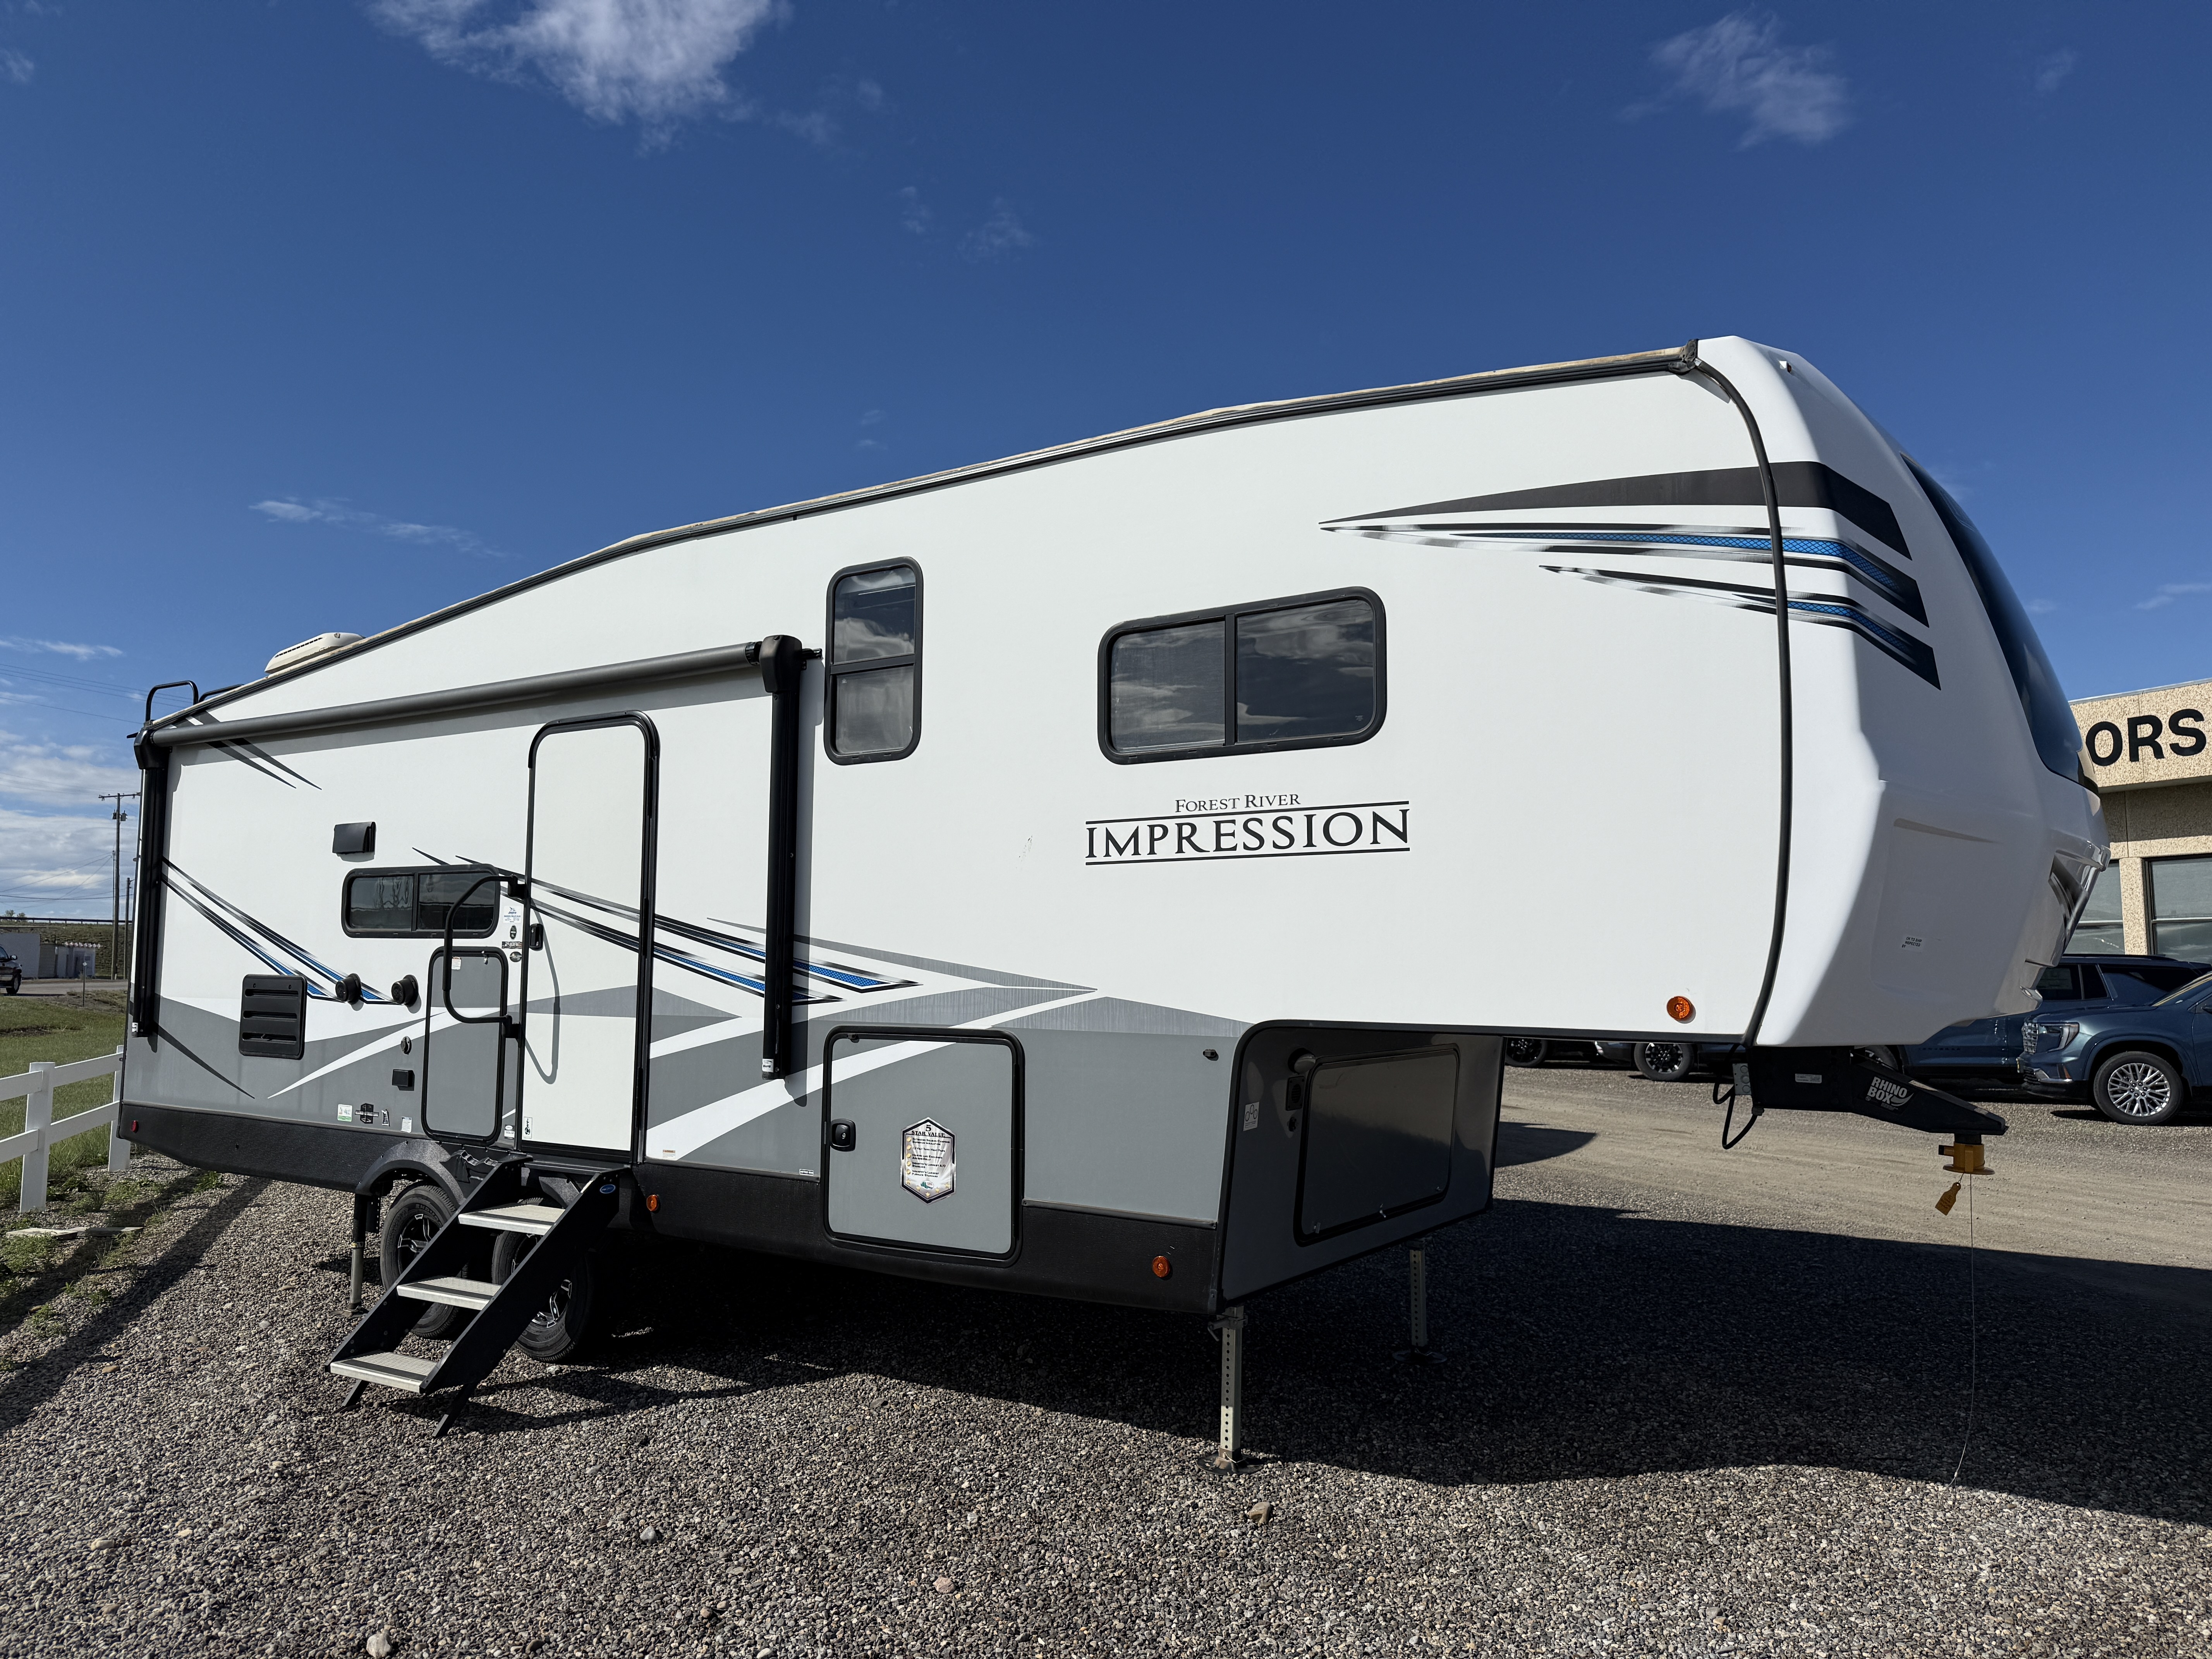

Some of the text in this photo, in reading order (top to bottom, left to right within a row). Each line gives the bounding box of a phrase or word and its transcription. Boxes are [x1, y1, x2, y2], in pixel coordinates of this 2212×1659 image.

[2086, 708, 2207, 766] ORS
[1175, 793, 1301, 813] FOREST RIVER
[1085, 809, 1410, 859] IMPRESSION
[1867, 1086, 1894, 1104] BOX
[1871, 1076, 1907, 1098] RHINO
